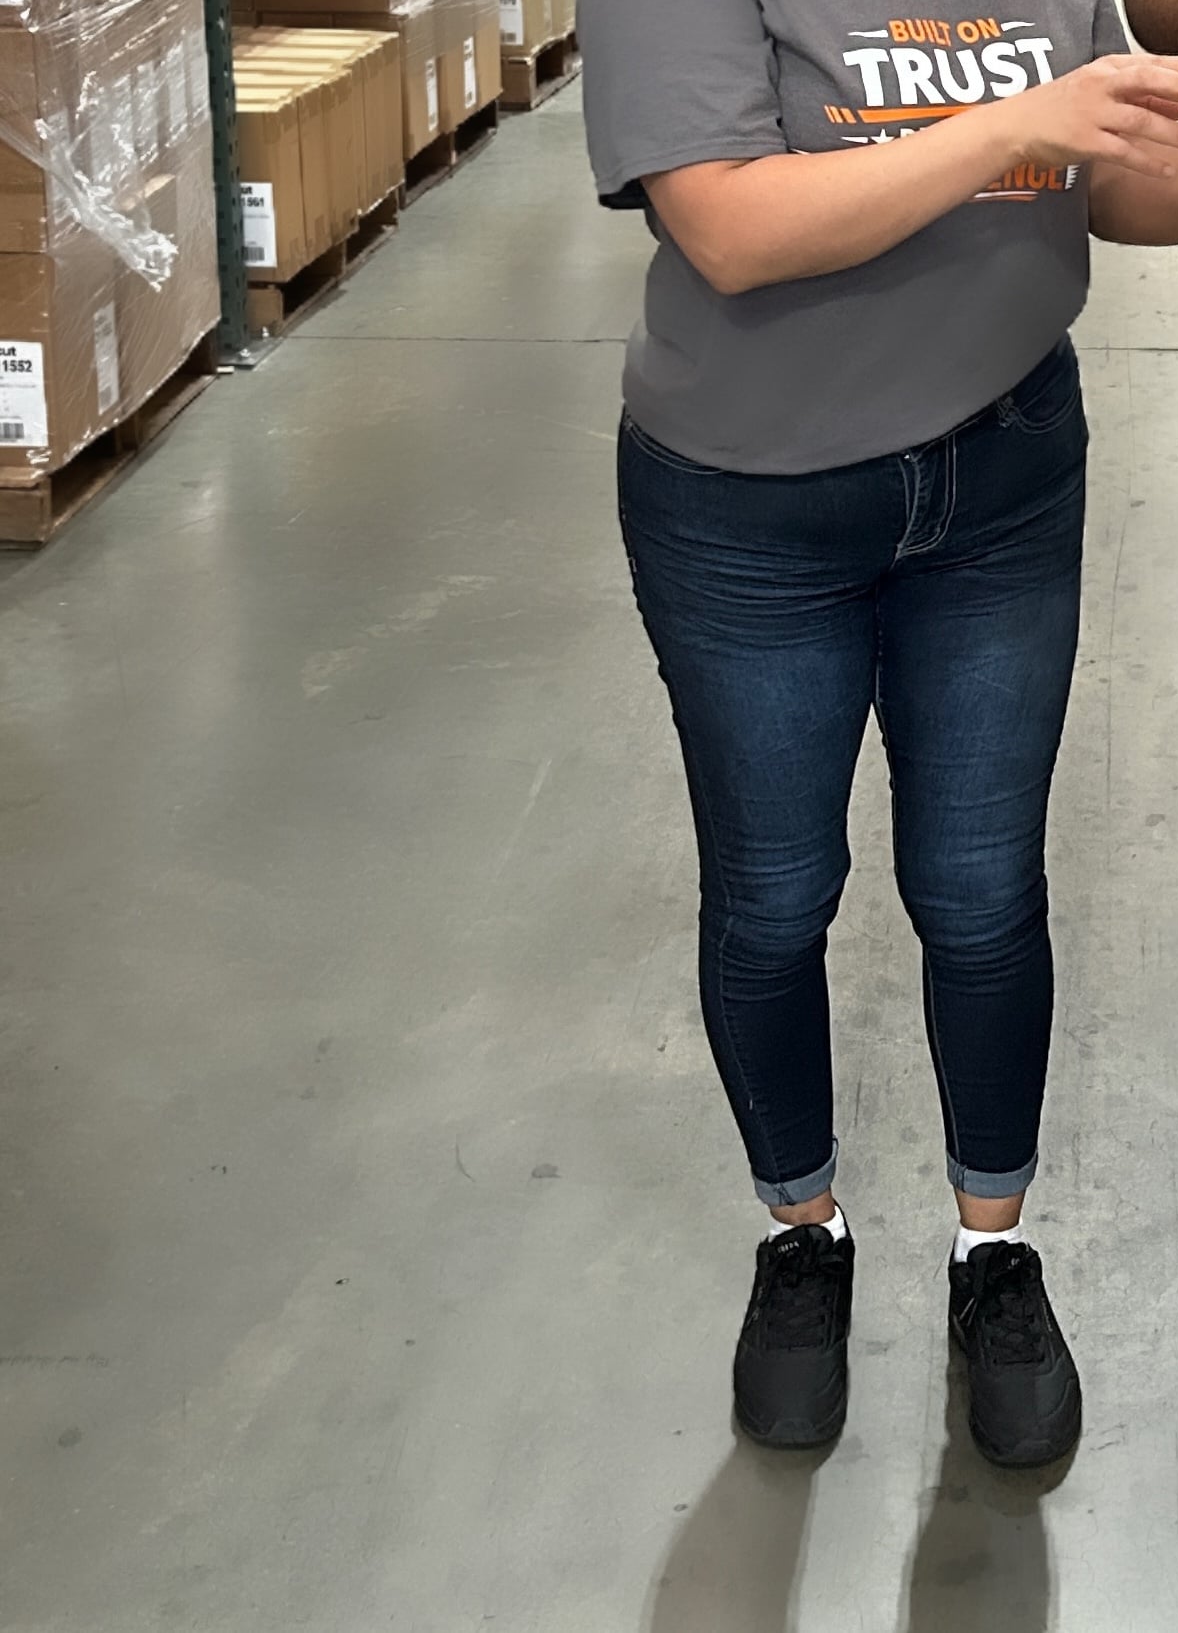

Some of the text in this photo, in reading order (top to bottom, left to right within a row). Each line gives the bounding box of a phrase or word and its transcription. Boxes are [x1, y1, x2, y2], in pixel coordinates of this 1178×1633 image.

[889, 18, 1001, 46] BUILT ON
[842, 37, 1053, 106] TRUST
